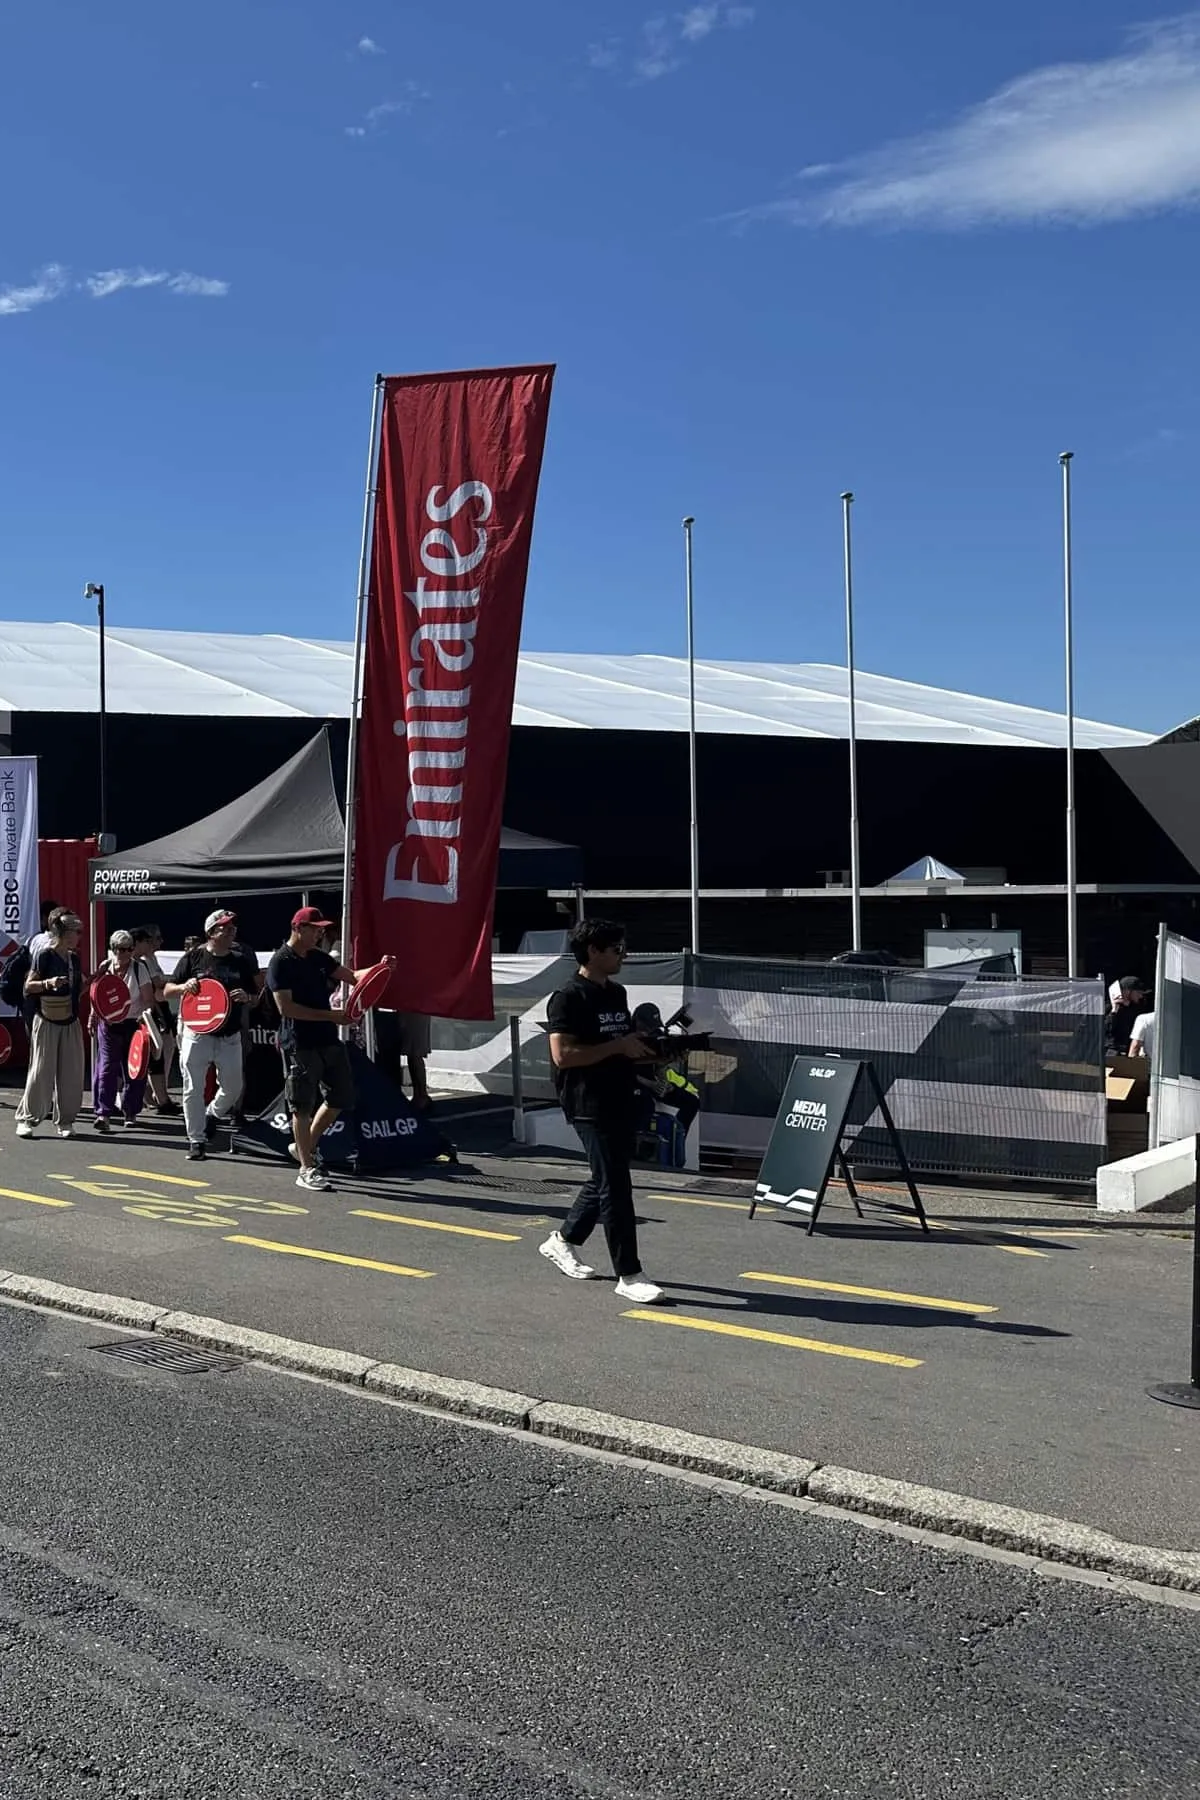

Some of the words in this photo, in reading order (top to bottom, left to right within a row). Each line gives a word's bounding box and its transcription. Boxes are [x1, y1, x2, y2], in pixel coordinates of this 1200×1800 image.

[383, 479, 495, 904] Emirates
[1, 770, 16, 813] Bank
[4, 817, 17, 872] Private
[94, 869, 150, 882] POWERED
[94, 882, 110, 895] BY
[4, 878, 20, 934] HSBC
[785, 1113, 828, 1132] CENTER
[792, 1099, 827, 1117] MEDIA
